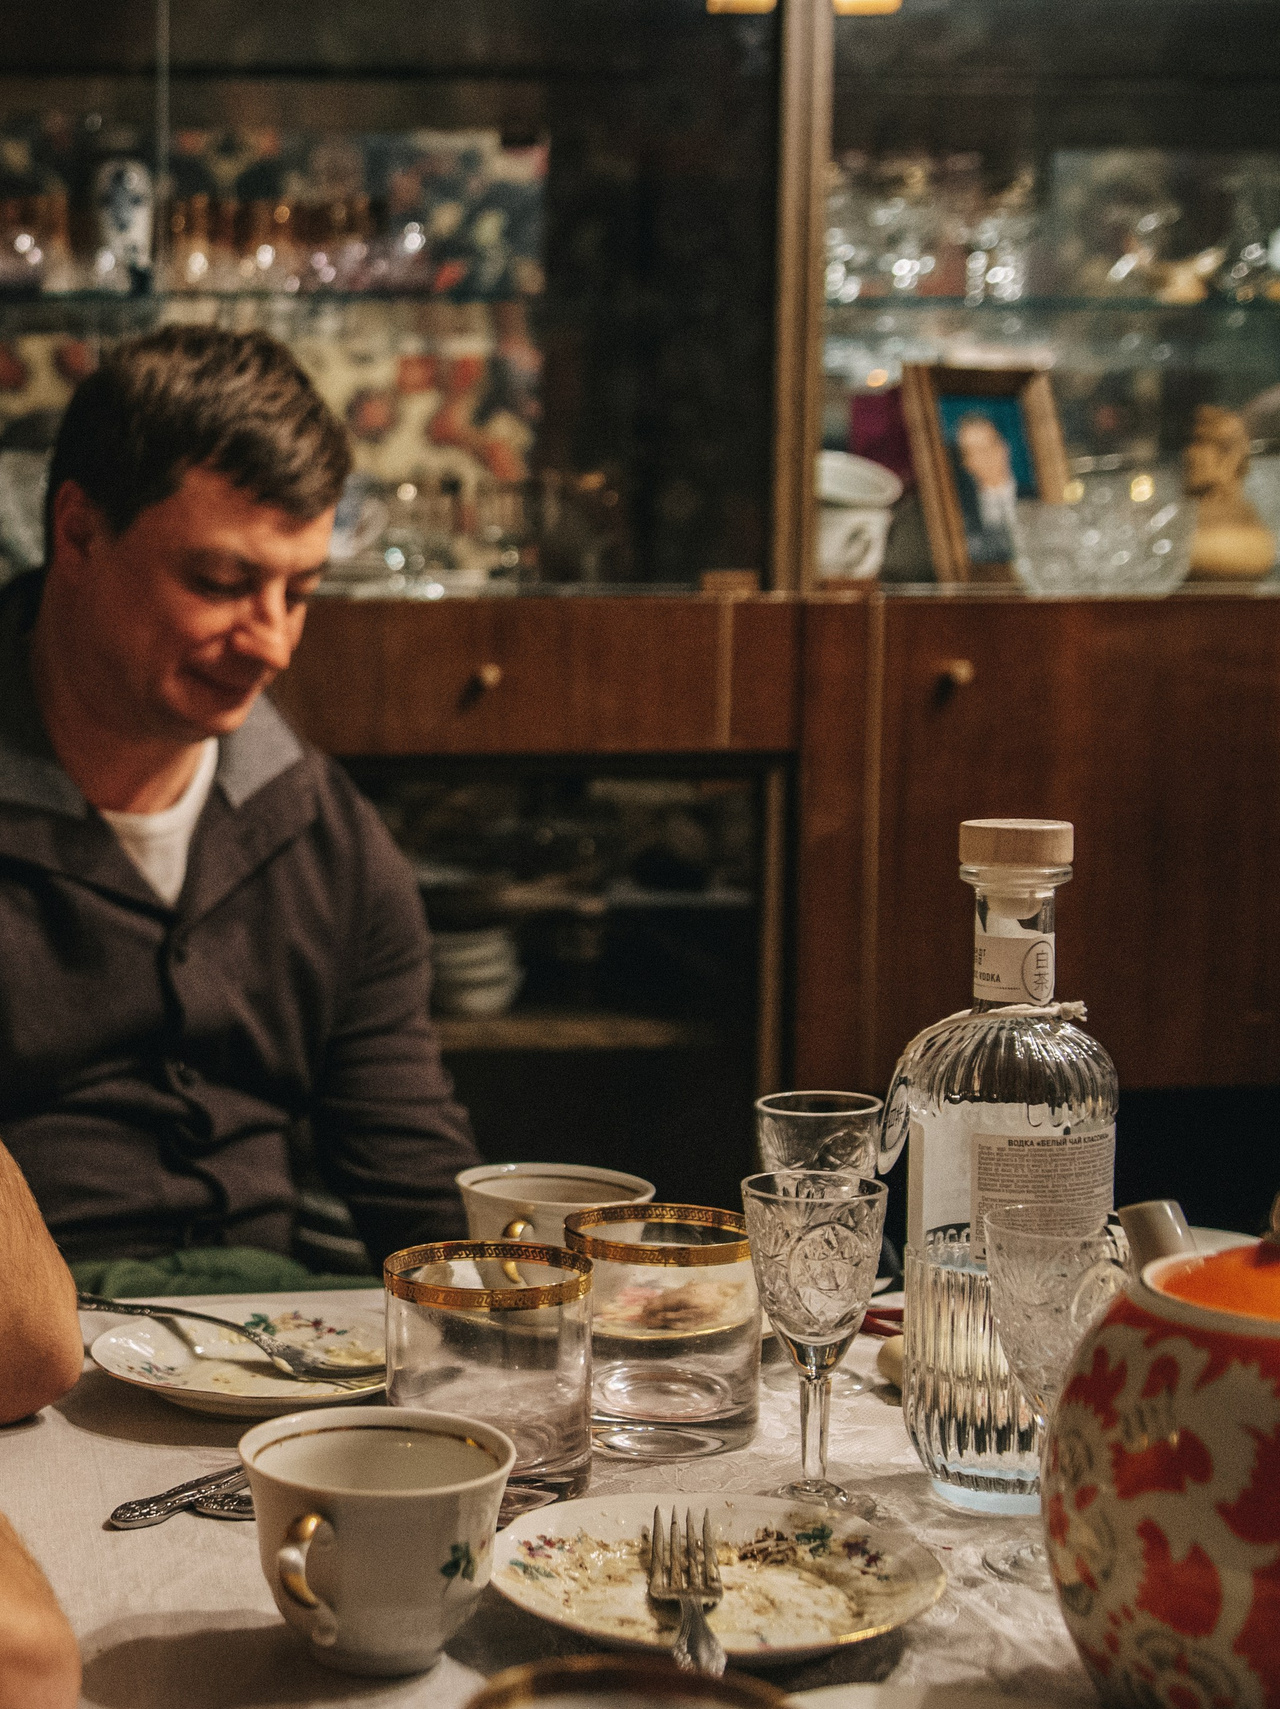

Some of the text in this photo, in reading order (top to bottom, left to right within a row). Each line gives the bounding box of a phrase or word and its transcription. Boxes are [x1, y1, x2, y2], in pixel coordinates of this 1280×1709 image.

[979, 971, 1001, 983] VODKA
[1008, 1139, 1035, 1147] ВОДКА
[1069, 1136, 1082, 1145] ЧАЙ
